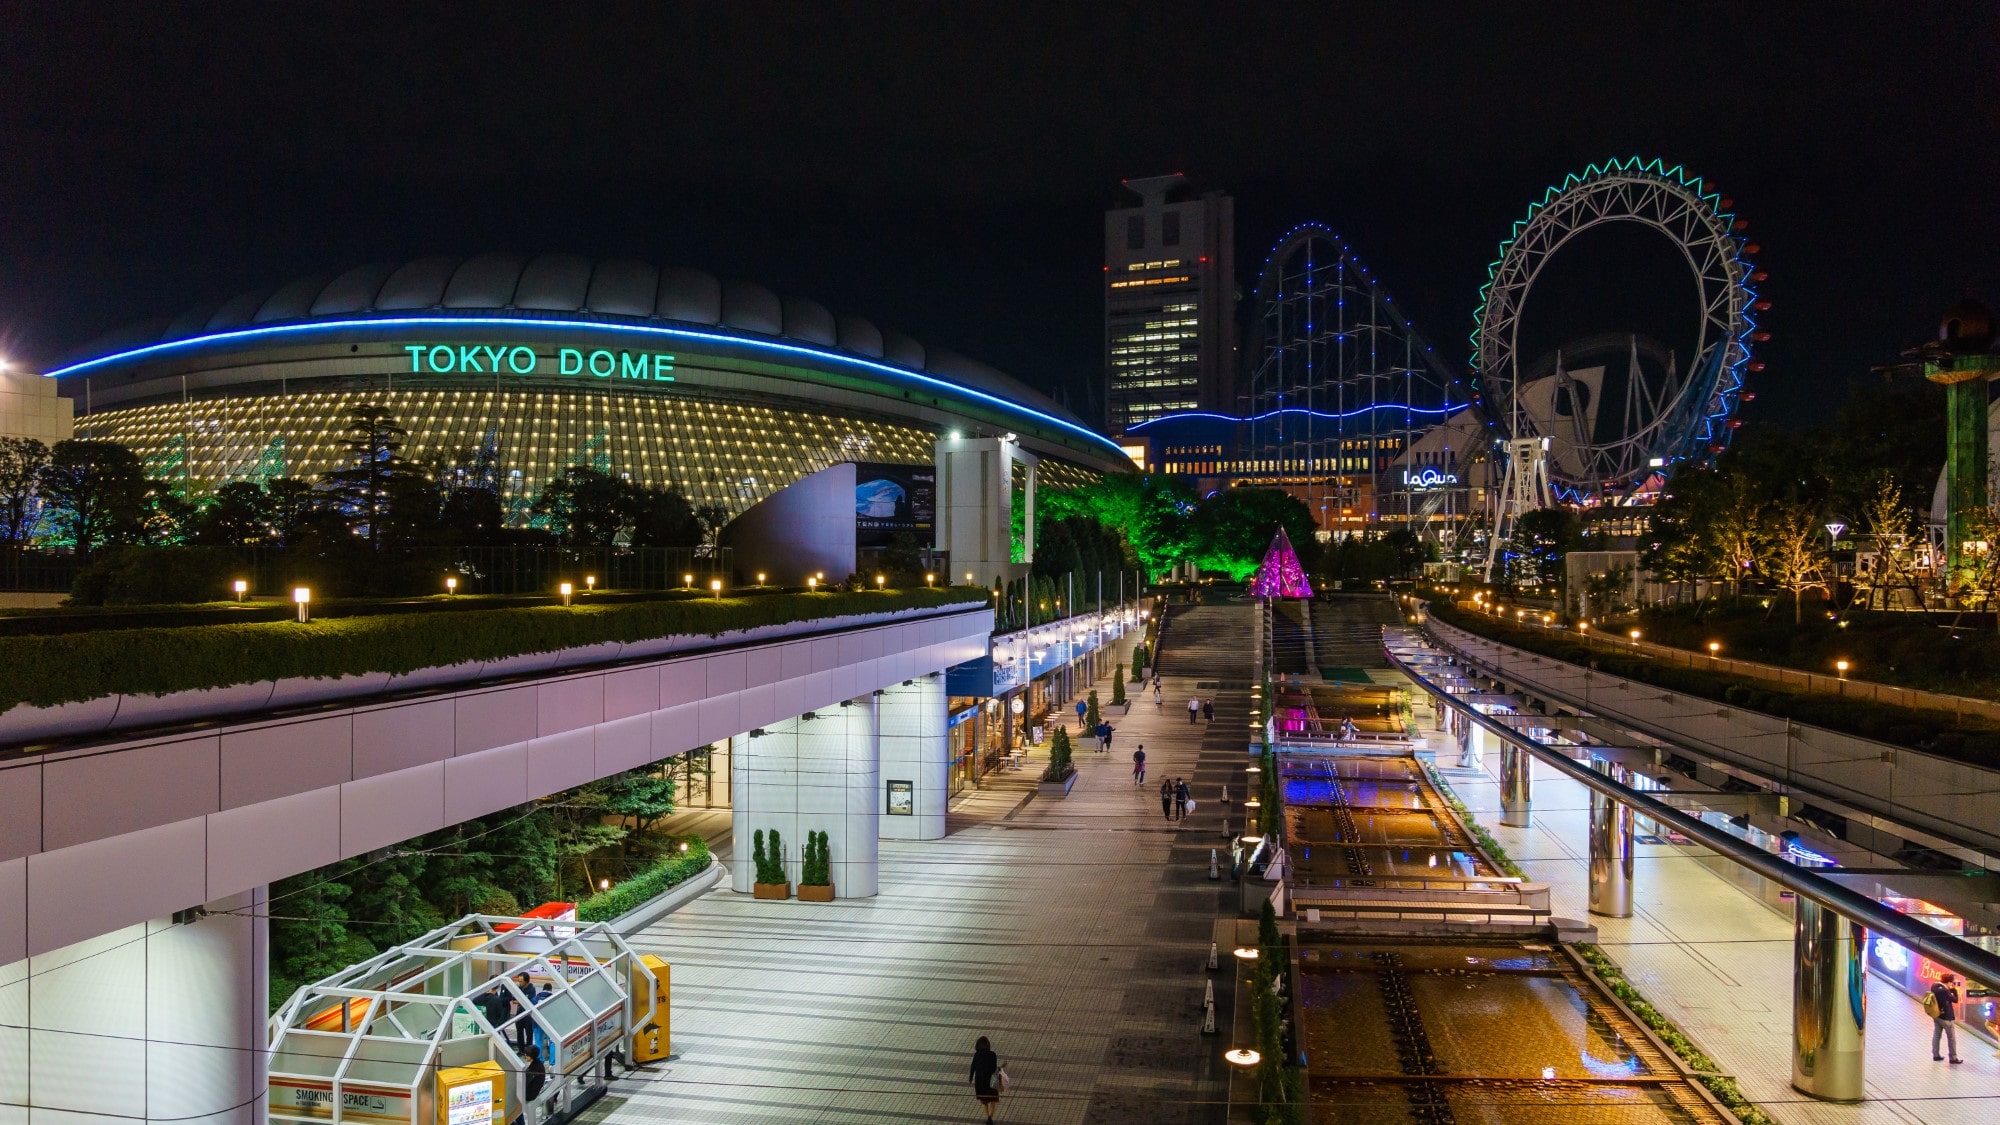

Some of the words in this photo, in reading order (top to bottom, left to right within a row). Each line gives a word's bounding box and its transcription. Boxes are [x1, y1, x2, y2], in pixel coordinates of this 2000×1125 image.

[404, 345, 536, 374] TOKYO
[560, 348, 675, 382] DOME
[296, 1089, 333, 1102] SMOKING
[343, 1093, 368, 1106] SPACE
